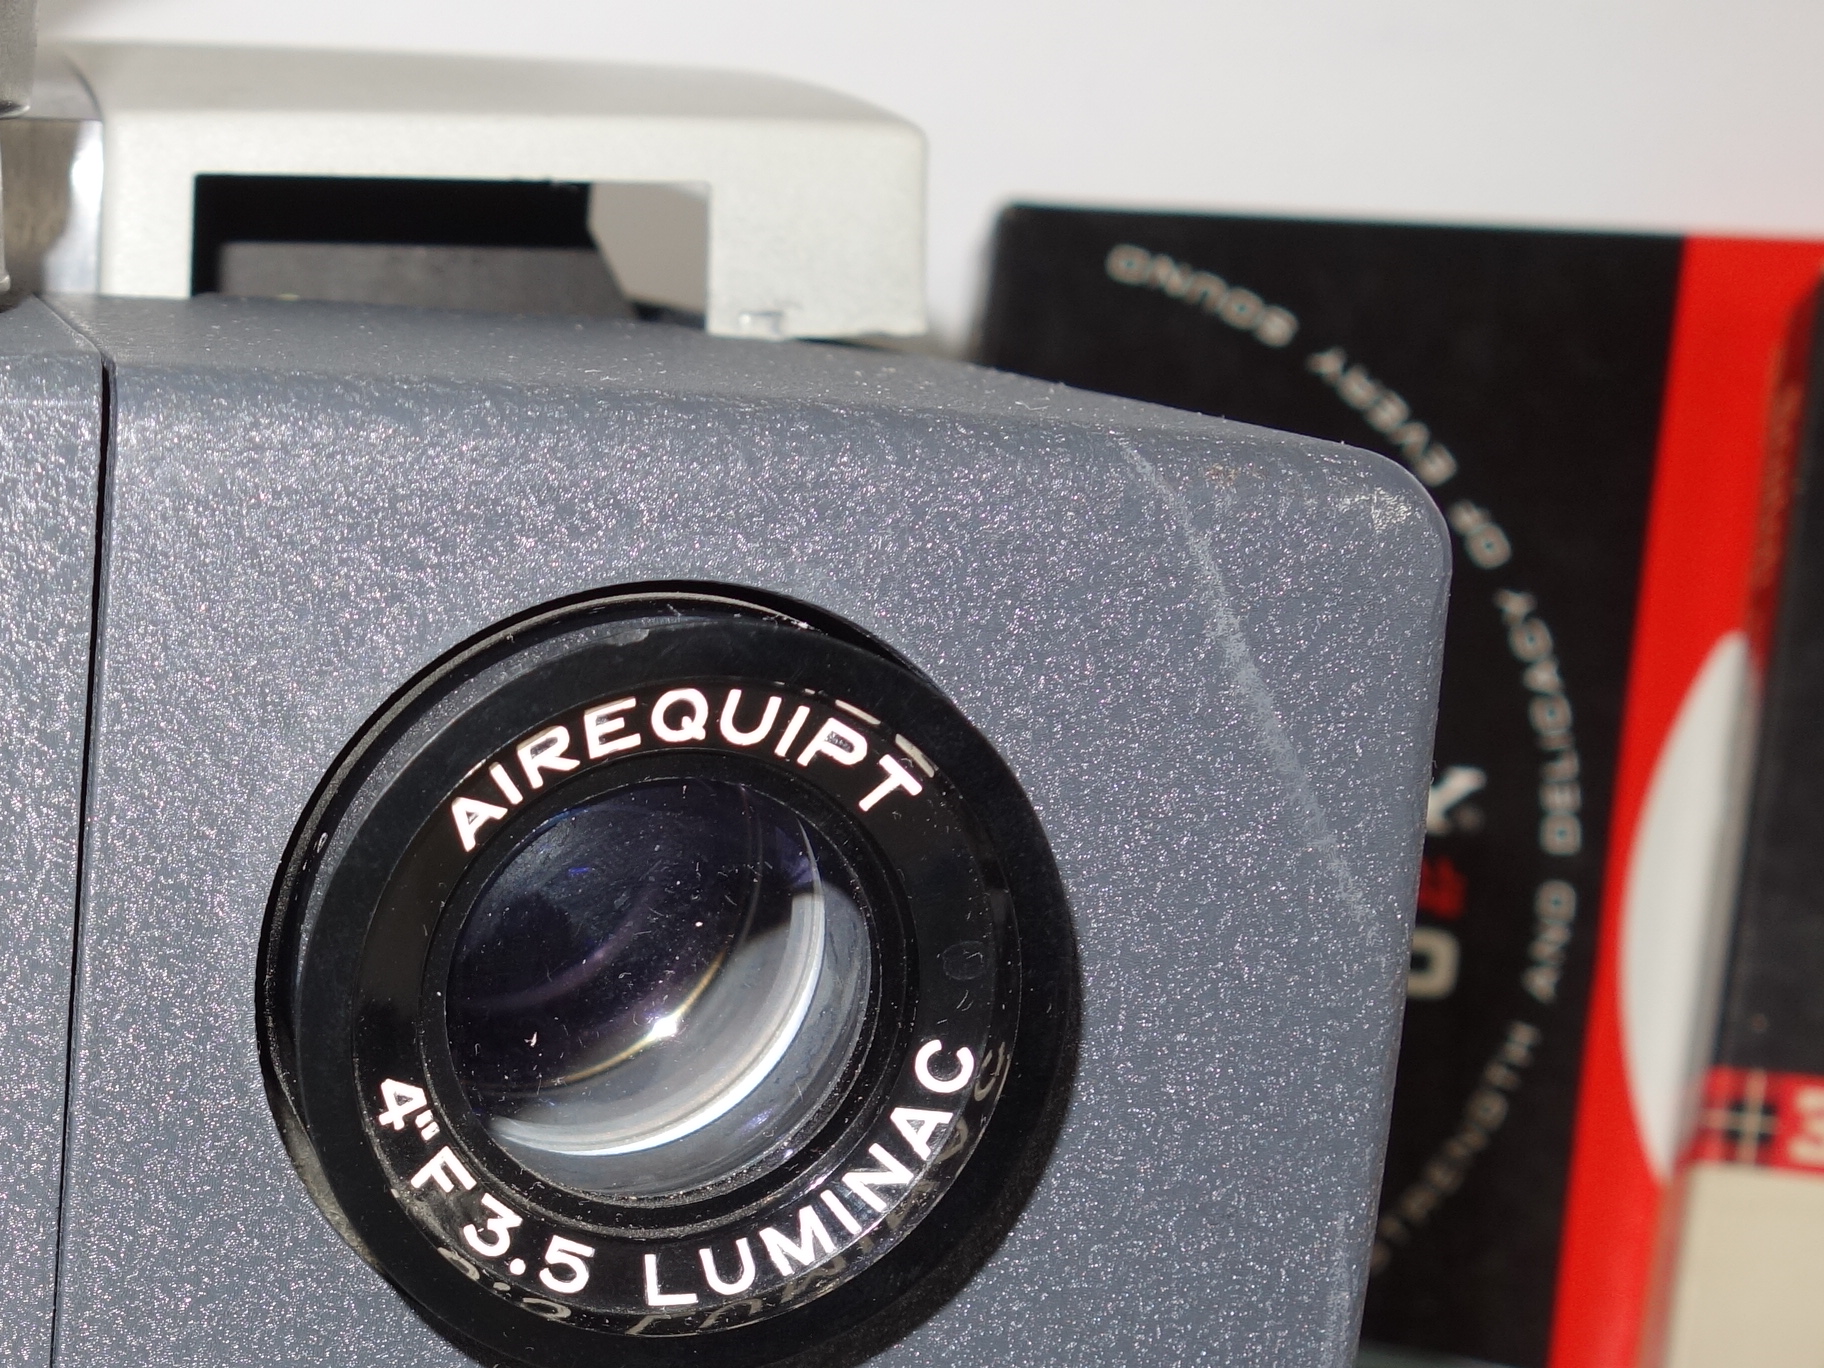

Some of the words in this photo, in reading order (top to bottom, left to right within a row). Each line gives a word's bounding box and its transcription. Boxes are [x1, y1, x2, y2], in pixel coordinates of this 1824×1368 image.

[1105, 243, 1299, 348] SOUND
[1306, 345, 1458, 488] EVERY
[449, 687, 924, 852] AIREQUIPT
[643, 1039, 974, 1306] LUMINAC
